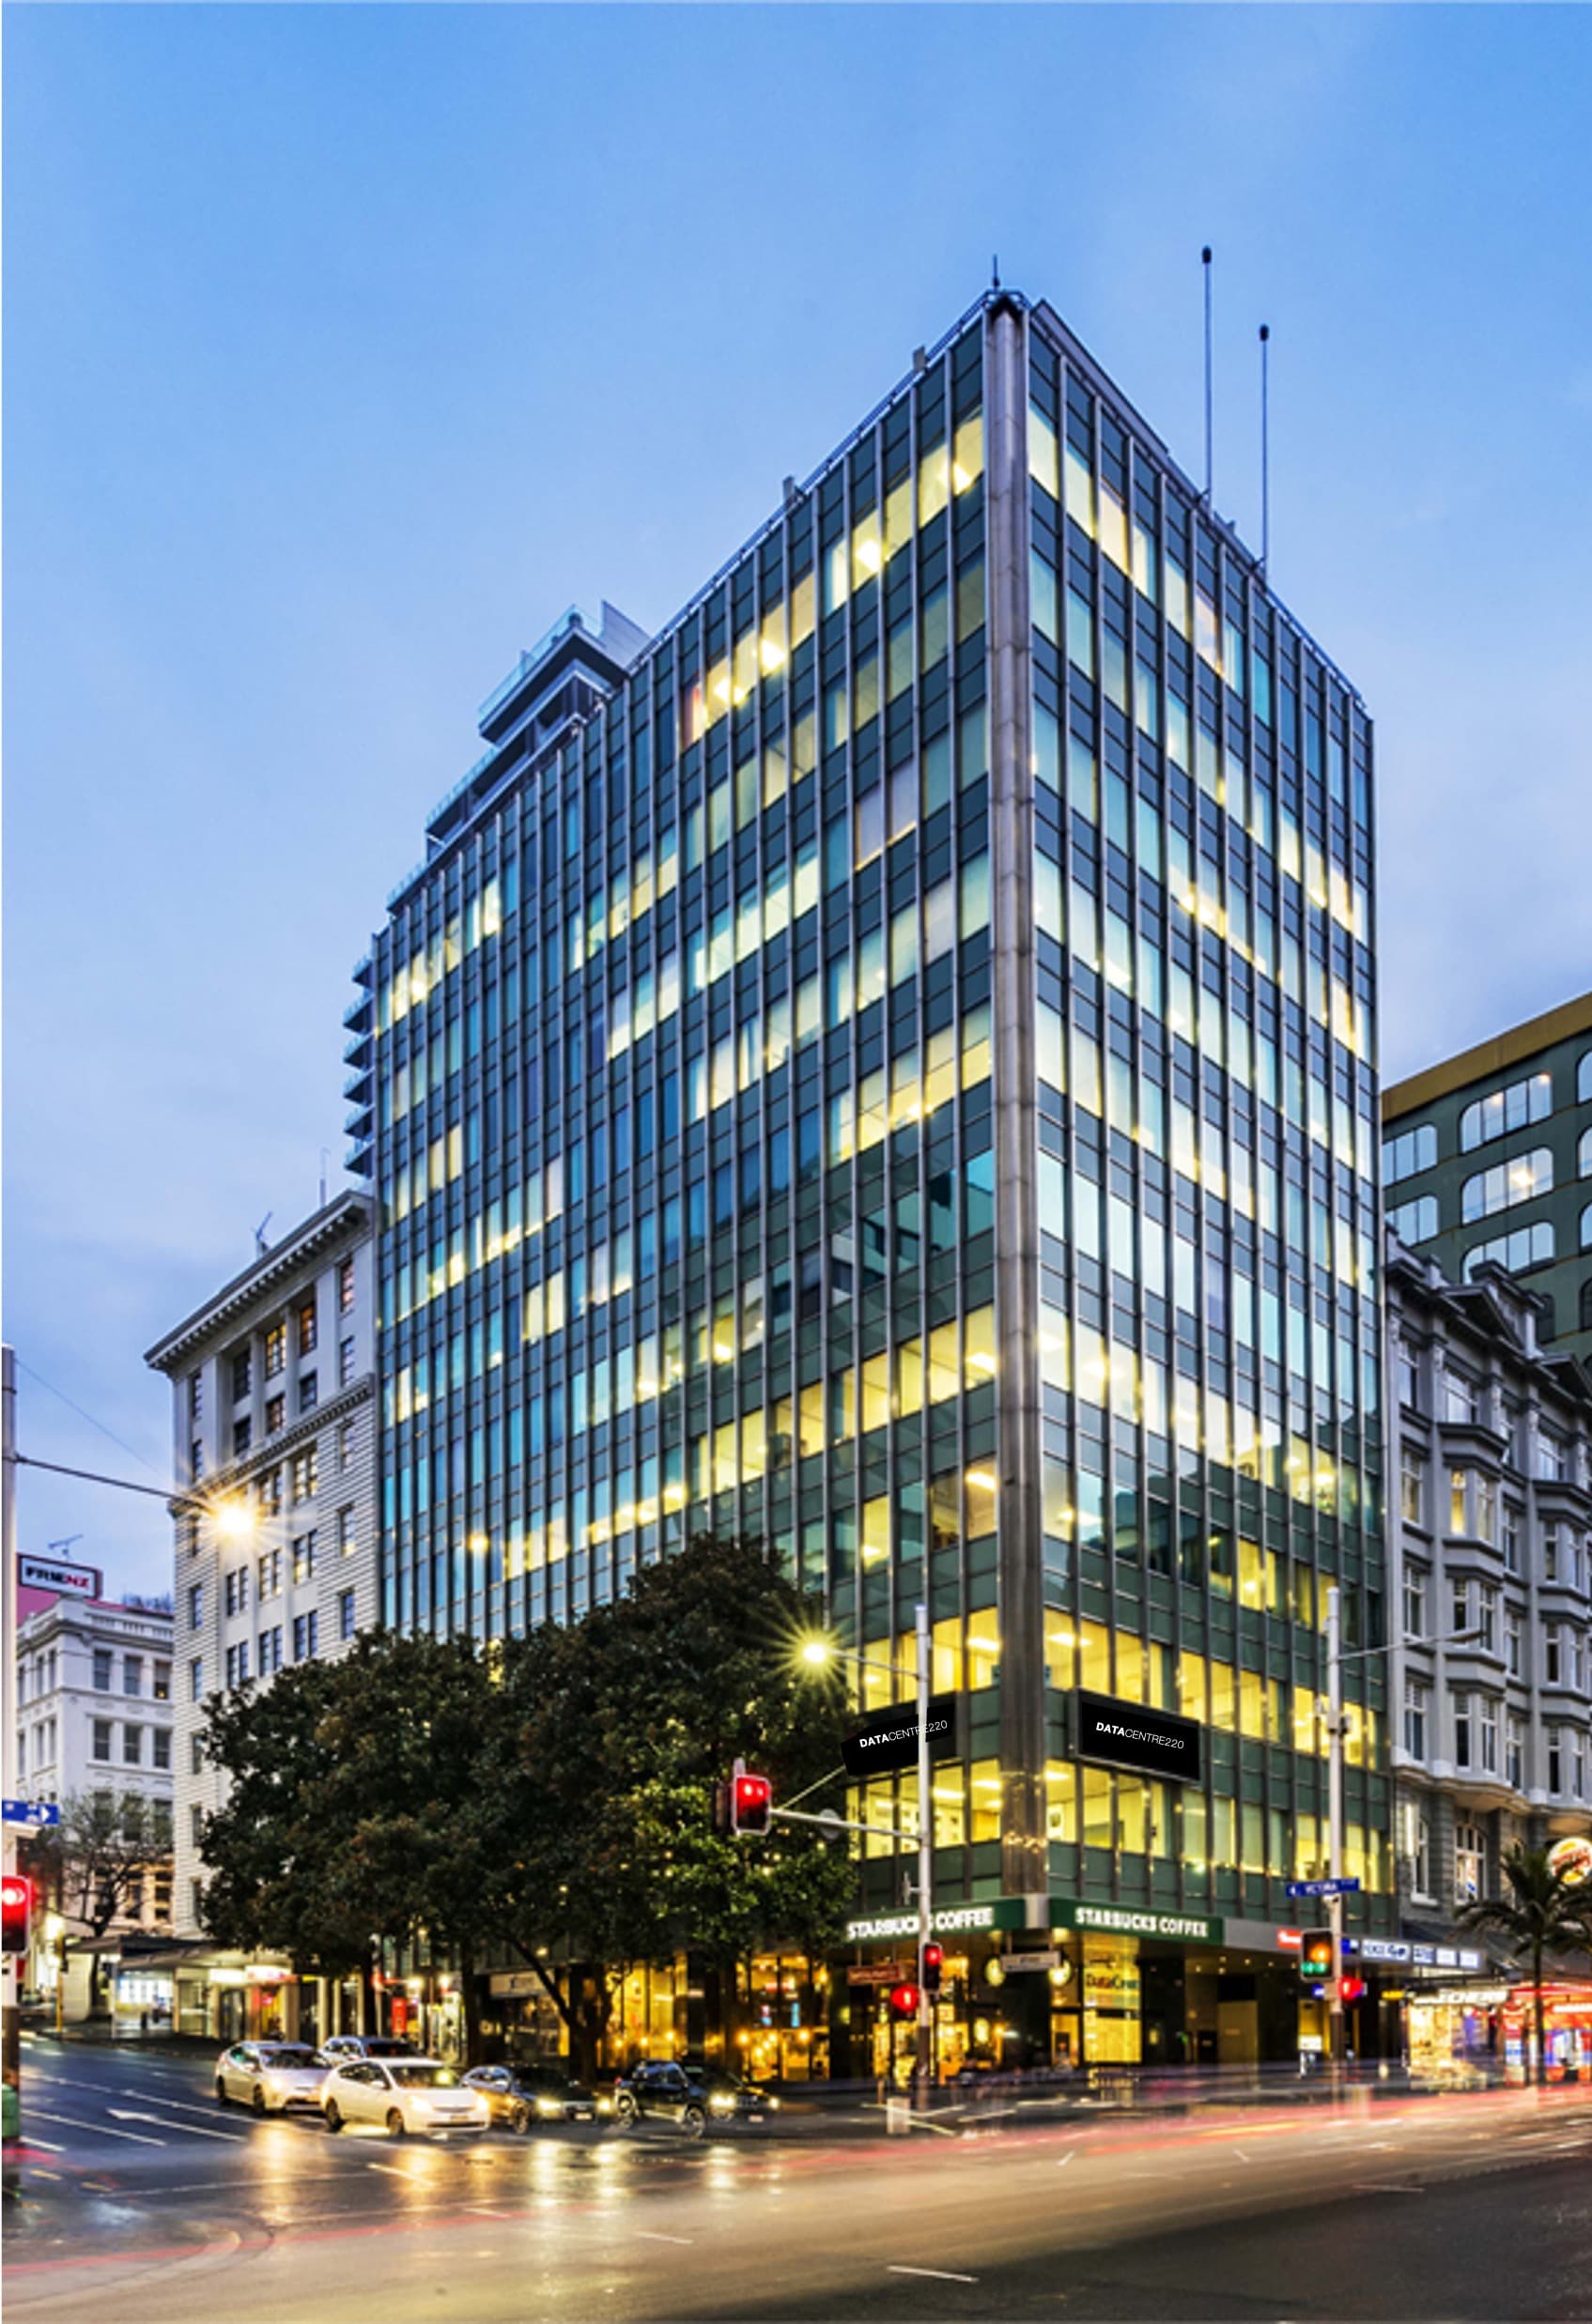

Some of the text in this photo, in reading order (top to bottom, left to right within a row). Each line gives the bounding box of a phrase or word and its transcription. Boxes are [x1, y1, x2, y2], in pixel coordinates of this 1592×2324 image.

[1095, 1721, 1184, 1749] DATACENTRE220
[847, 1906, 995, 1941] STARBUCS COFFEE
[1075, 1907, 1209, 1938] STARBUCKS COFFEE
